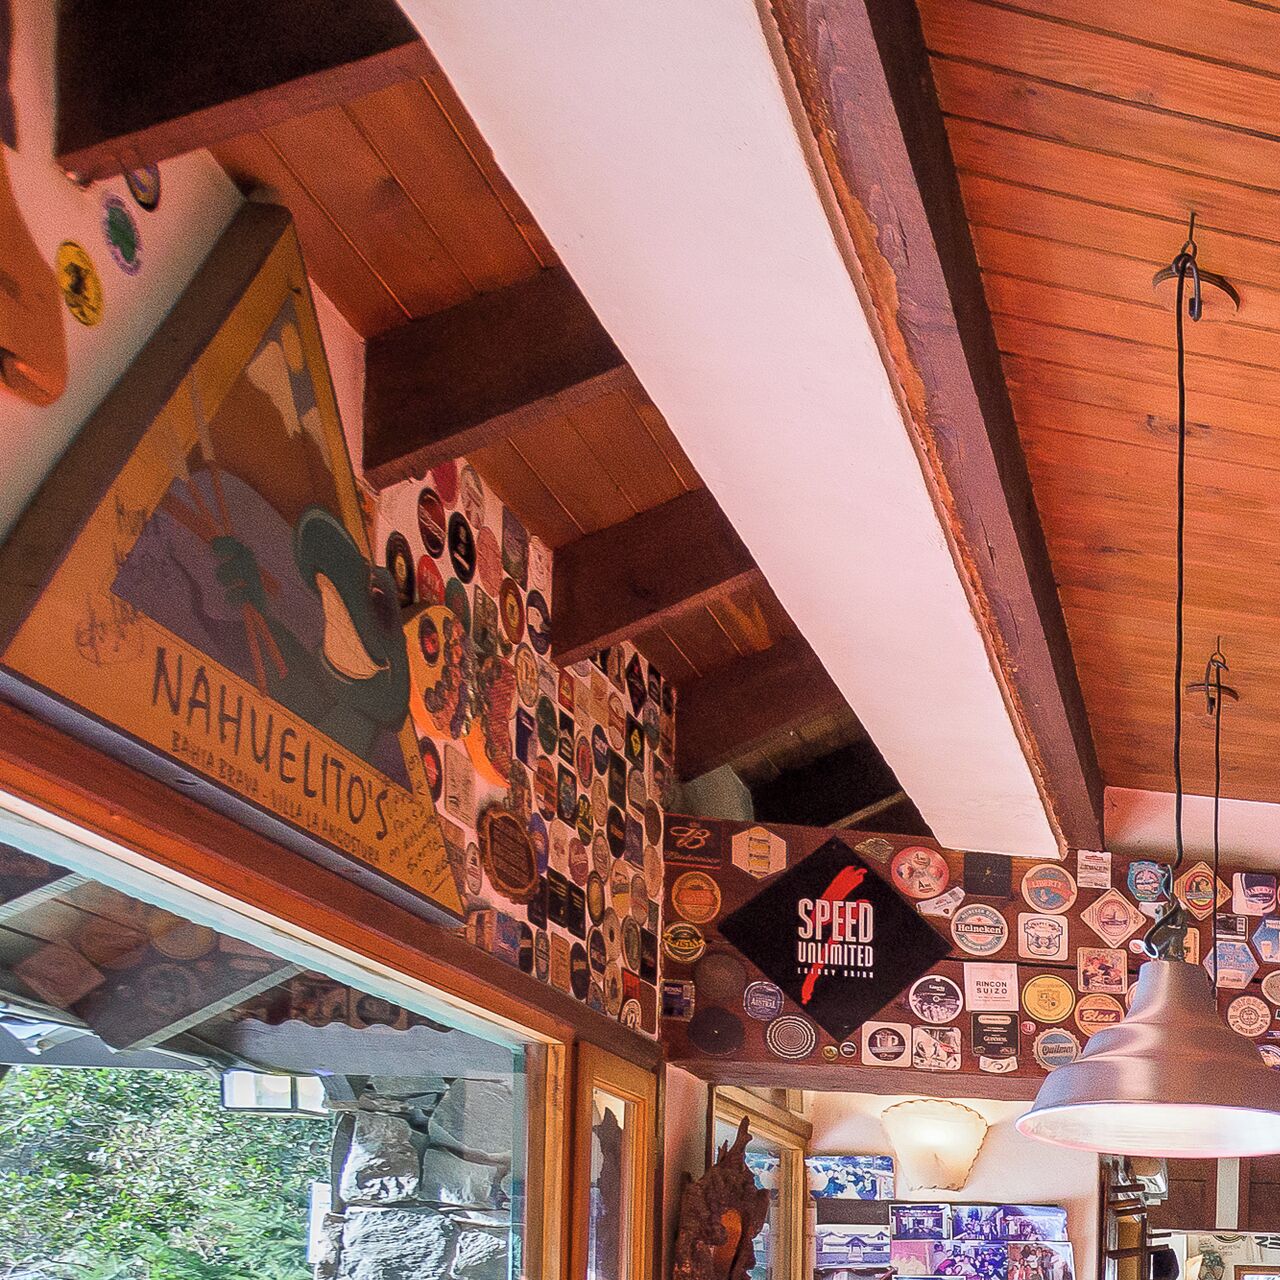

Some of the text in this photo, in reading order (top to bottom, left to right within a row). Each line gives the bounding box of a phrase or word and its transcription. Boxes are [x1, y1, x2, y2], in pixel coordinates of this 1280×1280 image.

[151, 646, 390, 841] NAHUELITO'S
[798, 898, 874, 944] SPEED
[957, 923, 1002, 934] Heineken
[797, 941, 874, 967] UNLIMITED
[975, 980, 1007, 988] RINCON
[976, 987, 1008, 995] SUIZO
[1082, 1009, 1117, 1023] Blest
